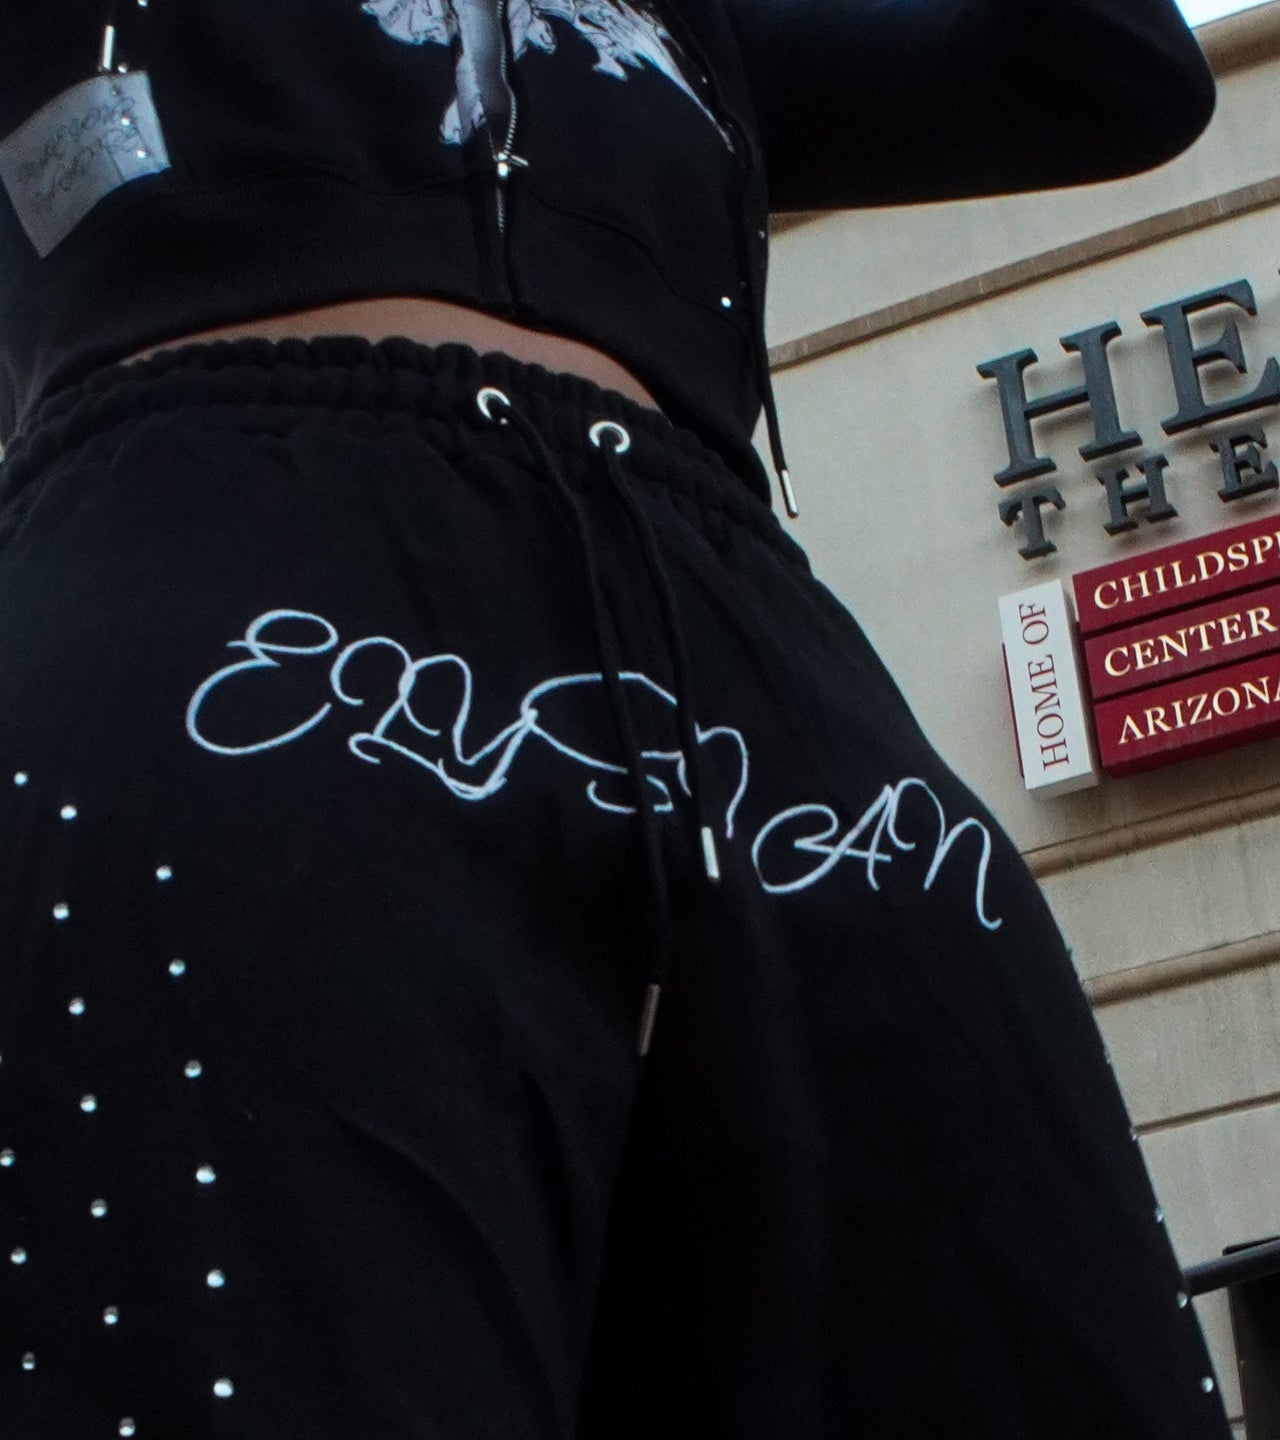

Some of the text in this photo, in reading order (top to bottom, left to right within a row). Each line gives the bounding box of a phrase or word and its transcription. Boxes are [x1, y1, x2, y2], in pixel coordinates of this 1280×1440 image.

[1019, 602, 1069, 771] HOME OF
[1105, 607, 1277, 676] CENTER
